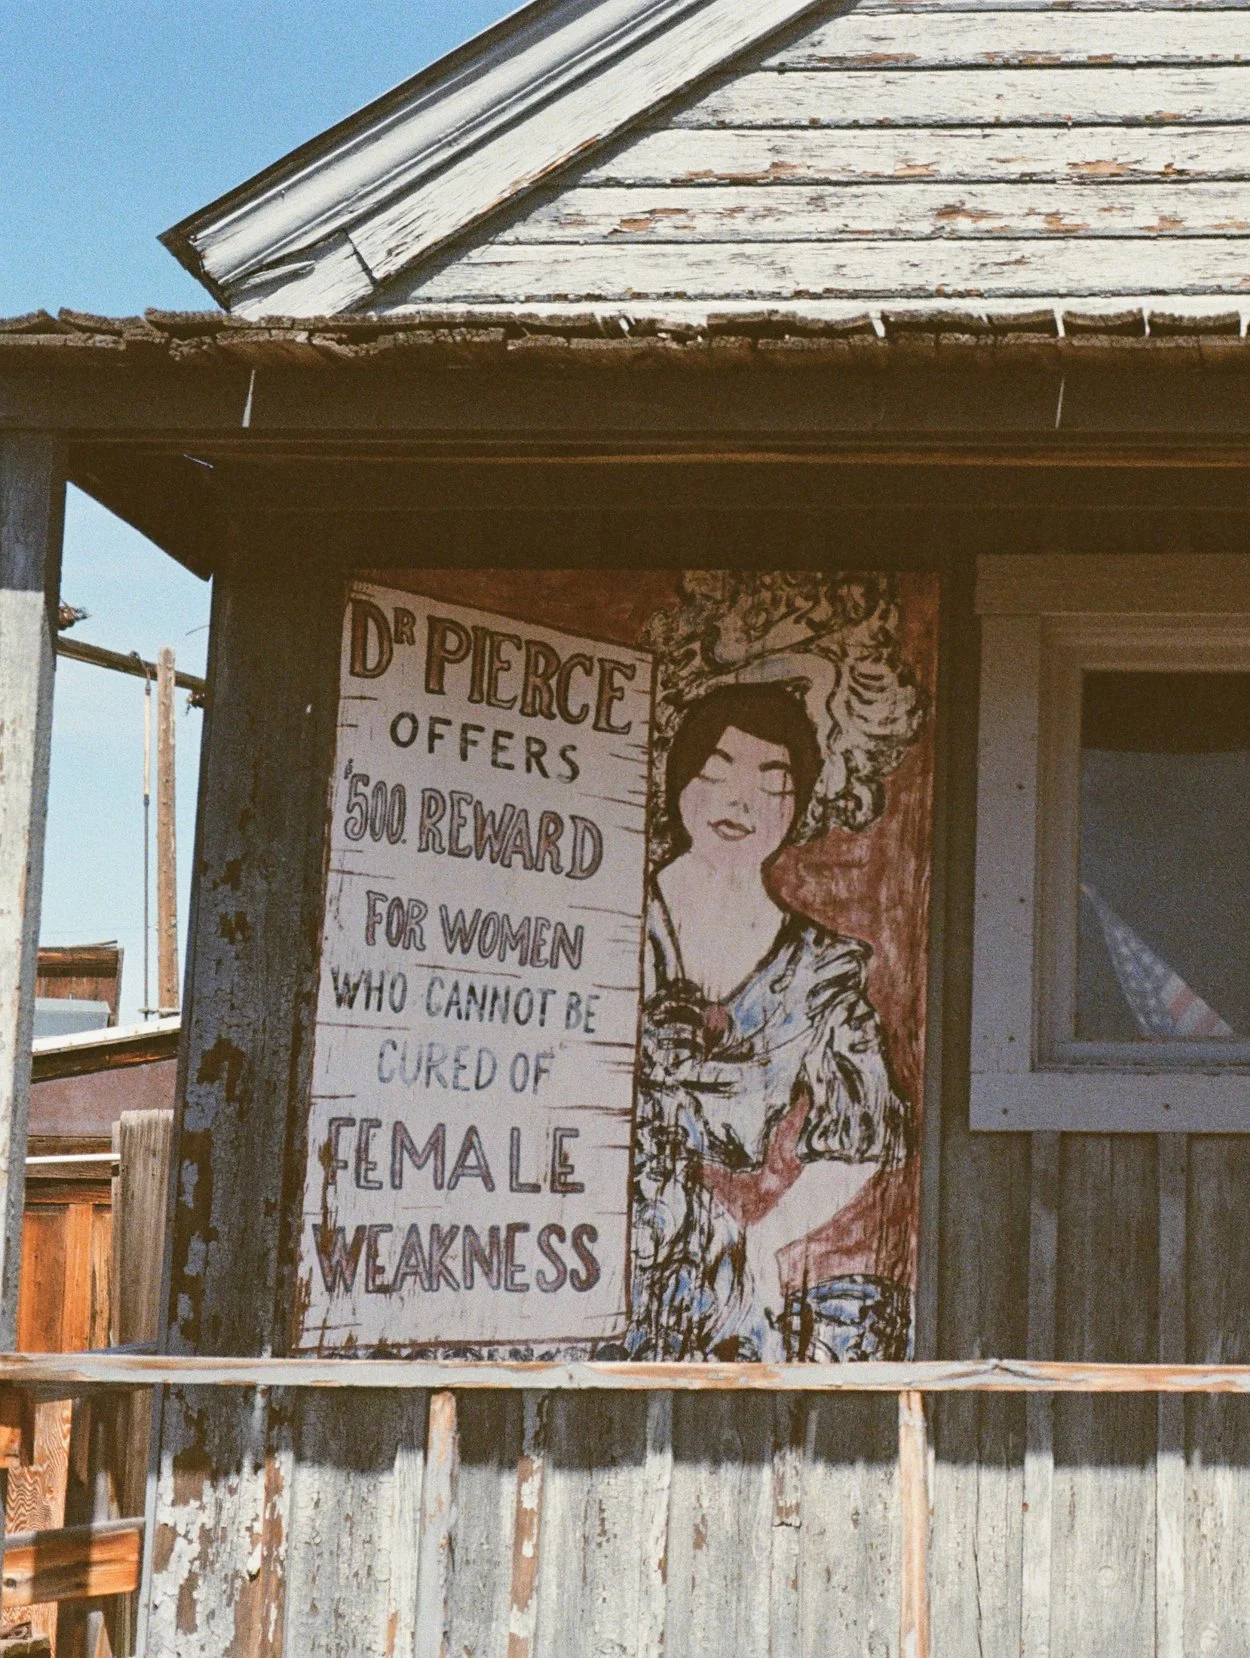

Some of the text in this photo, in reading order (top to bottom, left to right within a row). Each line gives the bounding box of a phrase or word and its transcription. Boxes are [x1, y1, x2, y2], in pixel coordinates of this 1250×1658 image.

[424, 615, 637, 735] PIERCE
[389, 711, 580, 784] OFFERS
[417, 787, 603, 880] REWARD
[365, 890, 584, 970] FOR WOMEN
[330, 966, 600, 1033] WHO CANNOT BE
[376, 1038, 556, 1095] CURED OF
[327, 1116, 585, 1194] FEMALE
[311, 1222, 600, 1294] WEAKNESS
